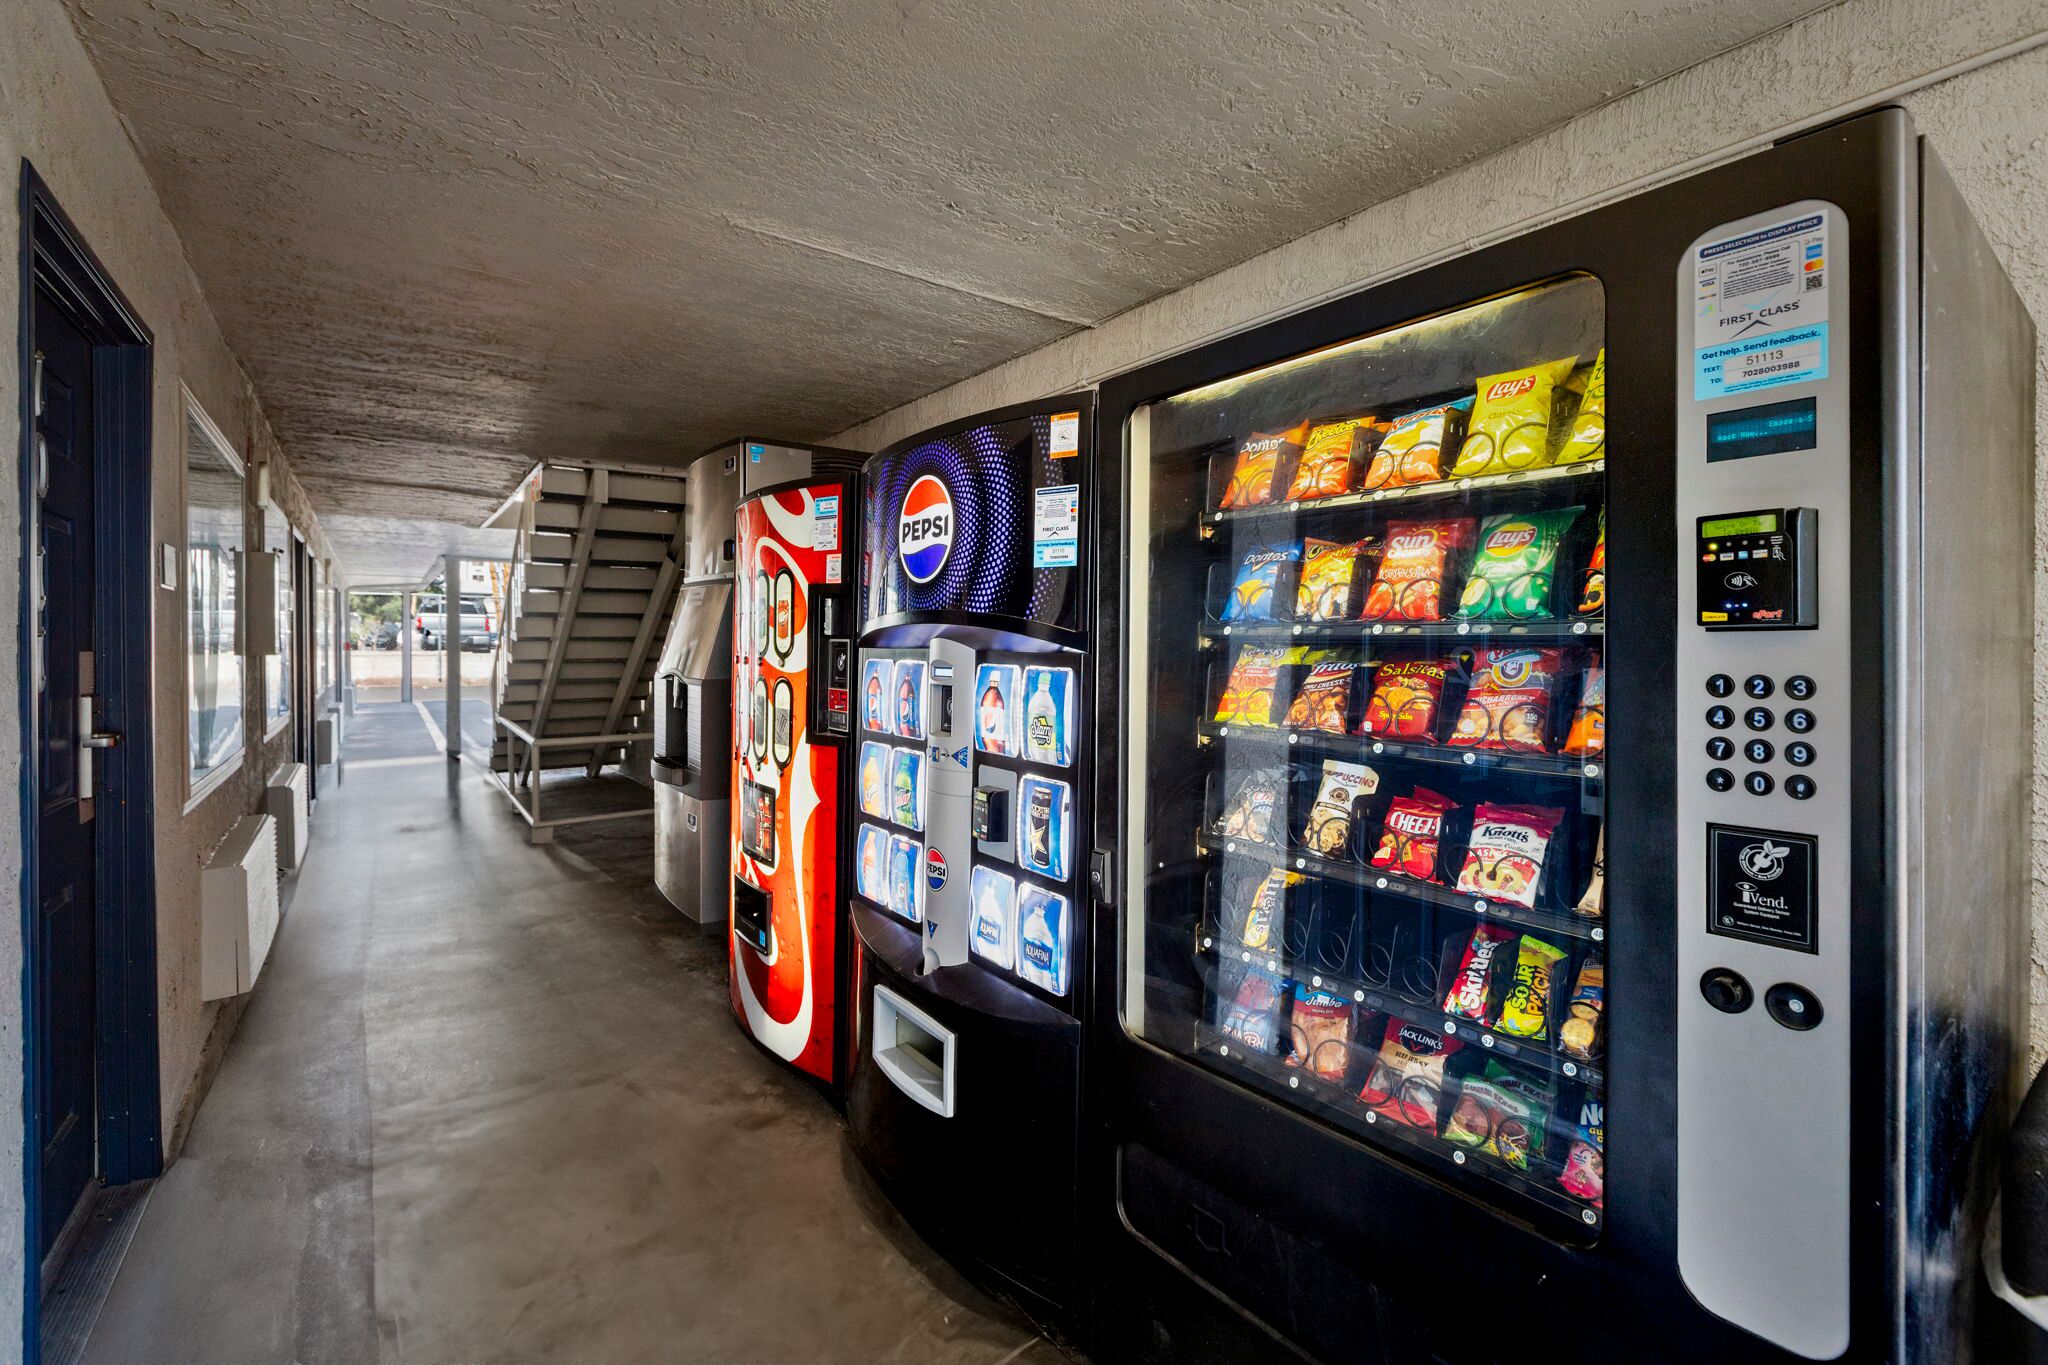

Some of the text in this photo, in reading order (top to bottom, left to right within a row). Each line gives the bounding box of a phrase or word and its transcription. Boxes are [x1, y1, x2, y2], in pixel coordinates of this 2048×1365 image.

[1704, 246, 1725, 256] PRESS
[1725, 237, 1760, 250] SELECTION
[1767, 225, 1797, 237] DISPLAY
[1797, 219, 1818, 228] PRICE
[1720, 302, 1800, 327] FIRST CLASS
[1702, 330, 1821, 360] Get help. Send feedback.
[1746, 350, 1784, 366] 51113
[1703, 365, 1722, 374] TEXT:
[902, 514, 949, 543] PEPSI
[1391, 536, 1430, 551] Sun
[1244, 551, 1289, 566] Doritos
[1380, 663, 1446, 680] Salsitas
[1716, 678, 1806, 696] 1 2 3
[1526, 712, 1538, 720] 150
[1713, 710, 1807, 728] 4 5 6
[1464, 754, 1474, 762] 36
[1715, 742, 1808, 762] 7 8 9
[1754, 776, 1765, 792] 0
[1389, 811, 1441, 836] CHEEZ-I
[1482, 826, 1529, 843] Knott's
[1026, 944, 1049, 964] AQUAFINA
[1512, 964, 1536, 1010] SOUR
[1398, 1027, 1418, 1042] JACK
[1482, 1037, 1492, 1046] 57
[1396, 1051, 1408, 1059] BEEF
[1564, 1065, 1574, 1074] 58
[1584, 1212, 1594, 1222] 68
